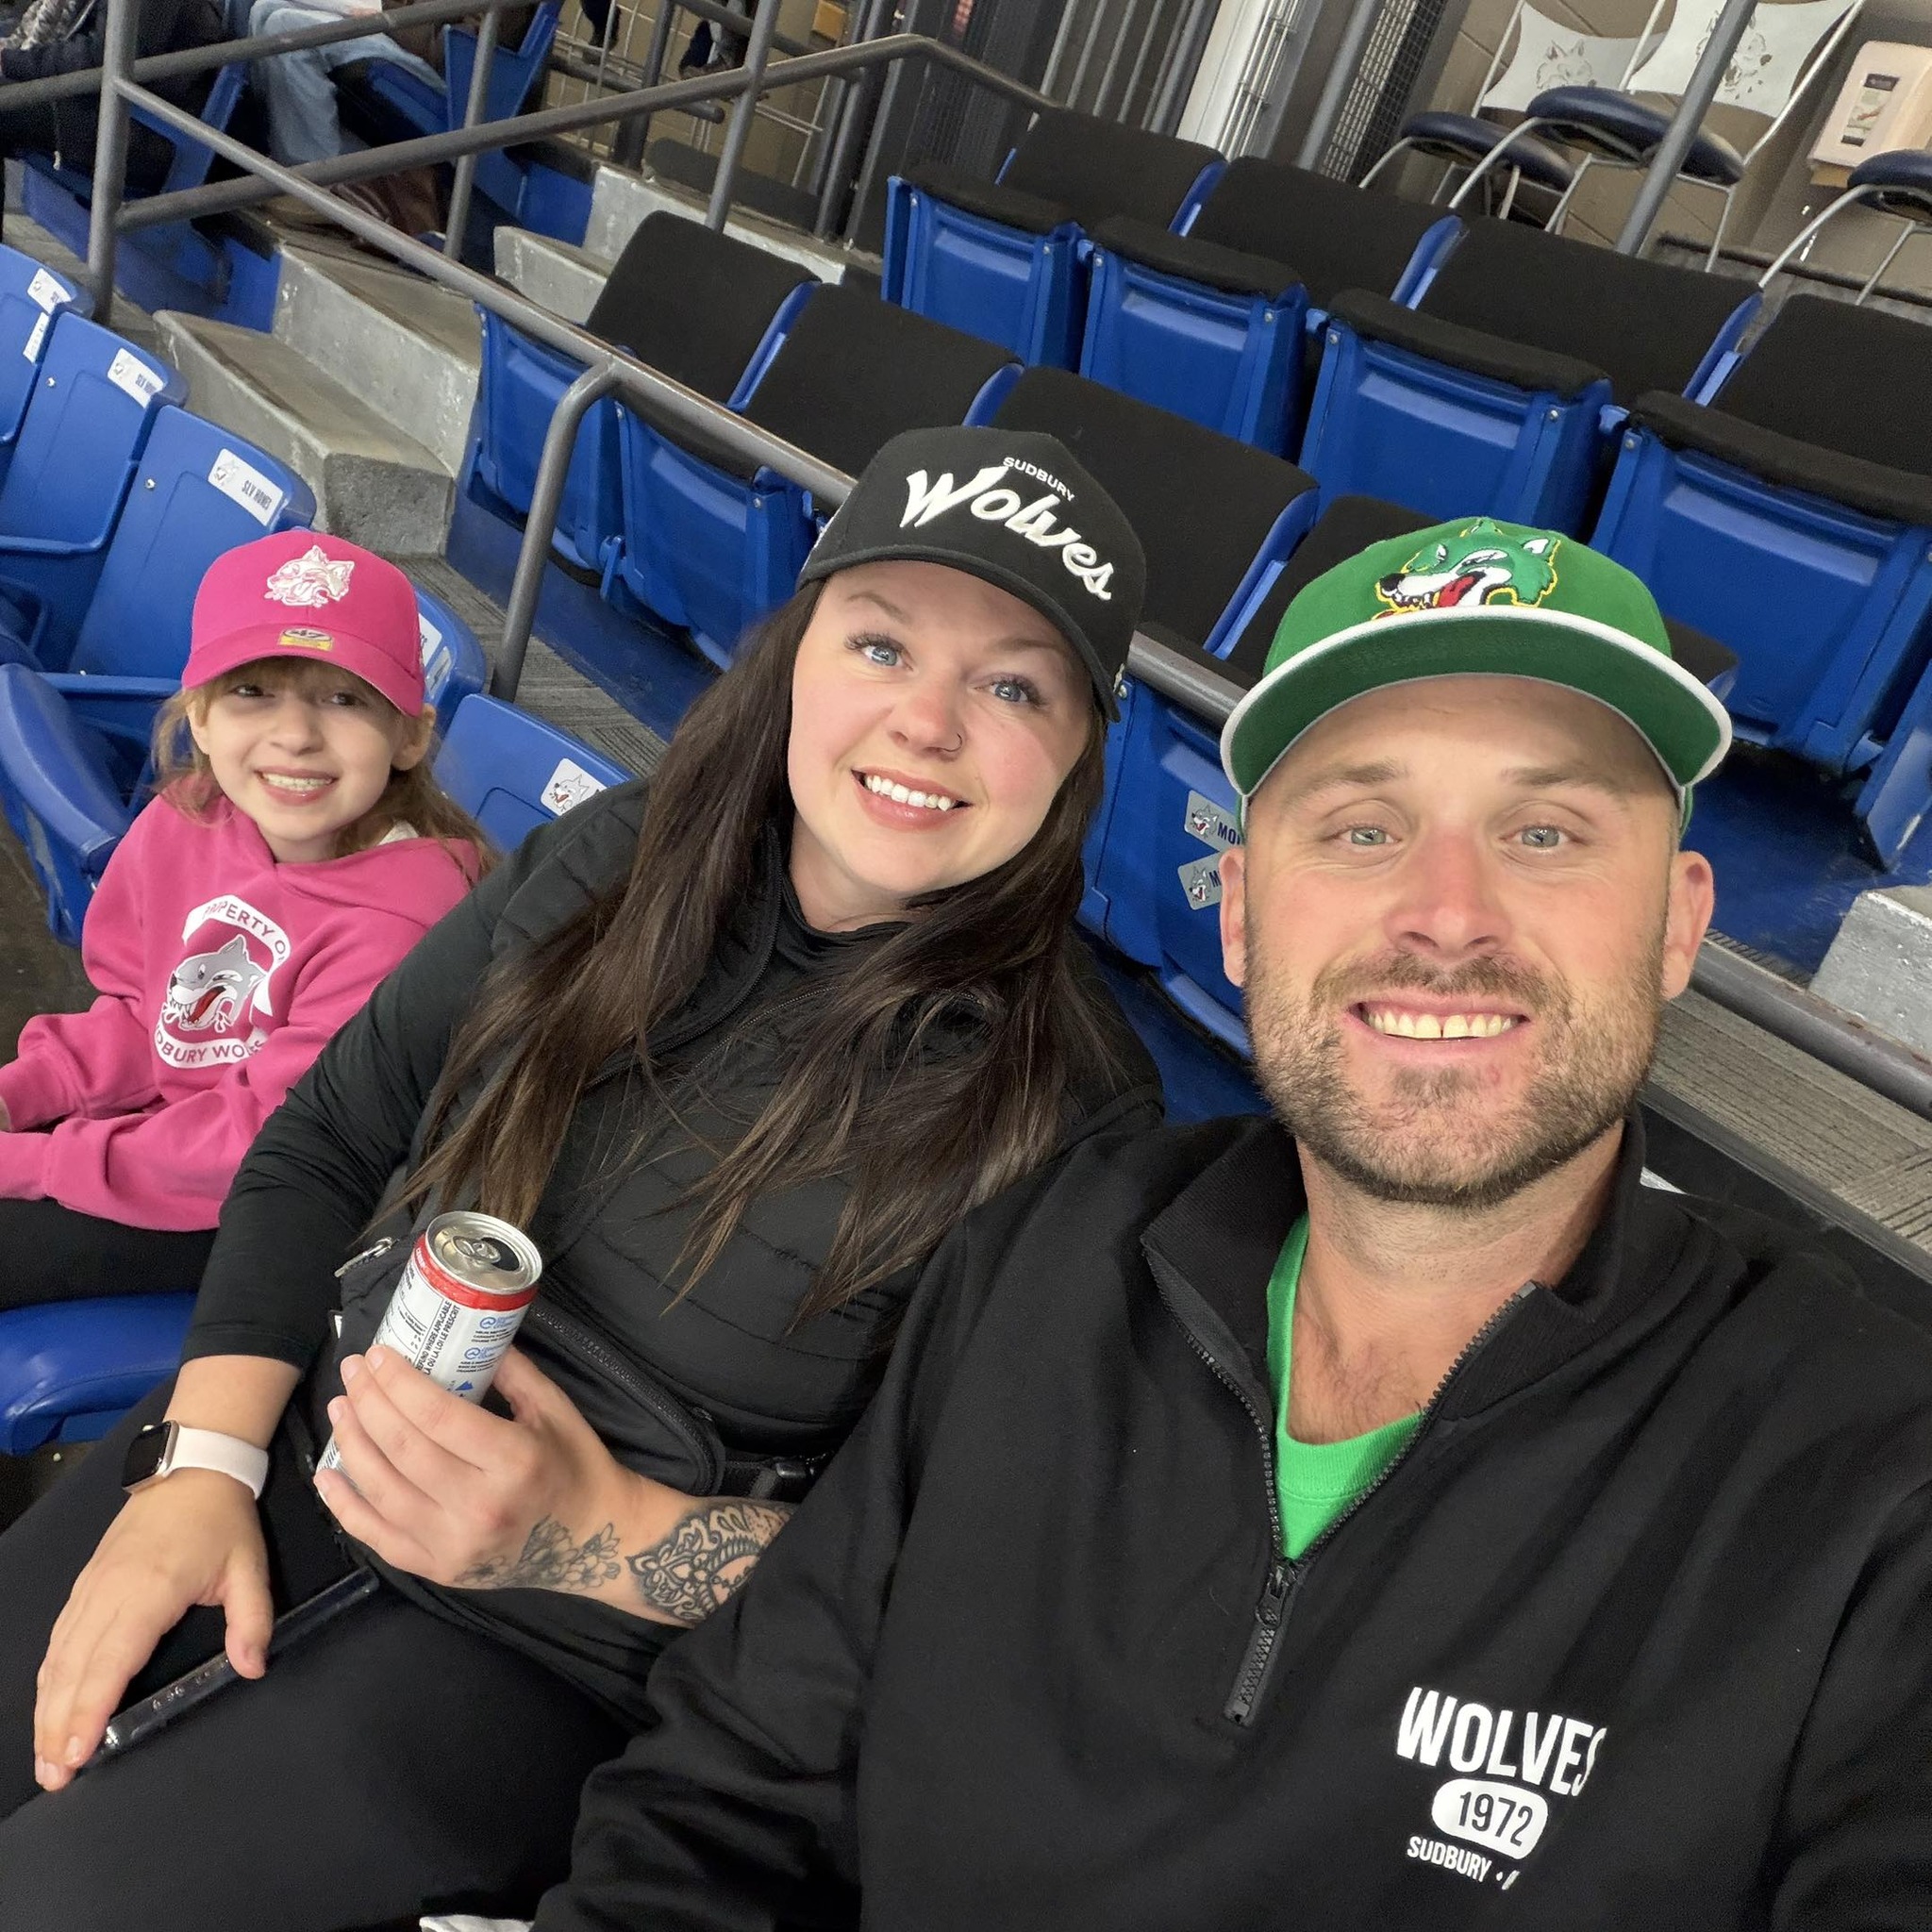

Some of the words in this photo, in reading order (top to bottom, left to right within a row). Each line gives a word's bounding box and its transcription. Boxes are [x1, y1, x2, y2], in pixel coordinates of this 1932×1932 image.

[1003, 457, 1075, 502] SUDBURY
[899, 466, 1114, 601] Wolves
[1217, 823, 1241, 845] MO
[425, 1331, 438, 1351] WHERE
[435, 1300, 452, 1334] APPLICABLE
[440, 1331, 448, 1341] LE
[443, 1305, 460, 1332] PRESCRIT
[431, 1350, 440, 1358] LA
[435, 1339, 444, 1351] LOI
[1396, 1687, 1607, 1797] WOLVES
[1458, 1791, 1533, 1847] 1972
[1407, 1836, 1492, 1883] SUDBURY
